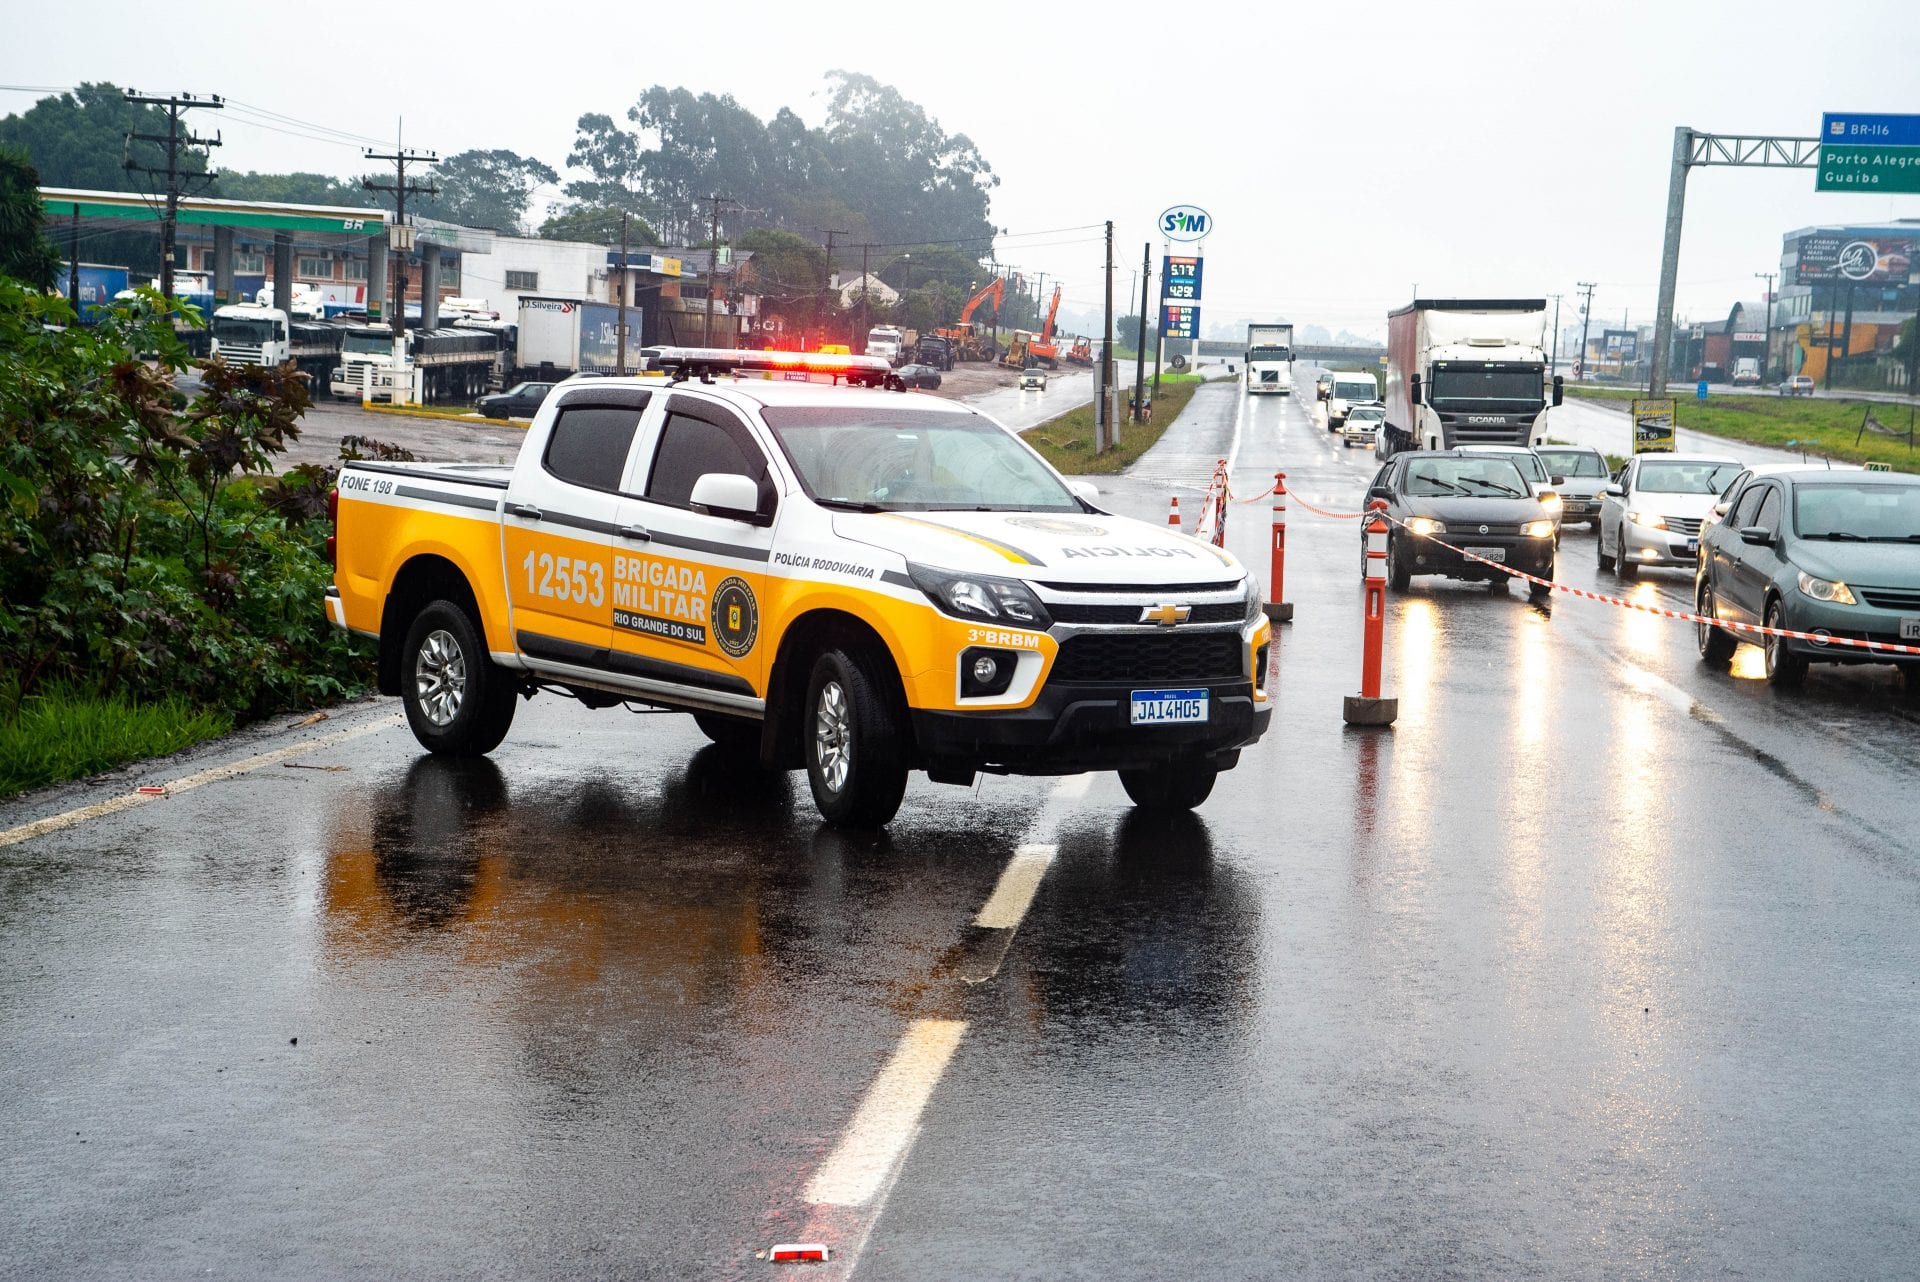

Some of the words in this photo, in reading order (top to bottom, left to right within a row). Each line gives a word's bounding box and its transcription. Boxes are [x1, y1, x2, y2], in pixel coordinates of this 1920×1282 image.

[1851, 124, 1889, 136] BR-116
[1826, 153, 1868, 165] Porto
[1872, 154, 1920, 168] Alegre
[1825, 170, 1879, 183] Guaíba
[343, 220, 364, 230] BR
[526, 301, 562, 311] J.Silveira
[1468, 416, 1506, 424] SCANIA
[1868, 463, 1888, 472] TAXI
[341, 475, 371, 491] FONE
[373, 479, 393, 495] 198
[774, 552, 810, 569] POLÍCIA
[812, 558, 875, 579] RODOVIÁRIA
[523, 550, 605, 608] 12553
[613, 555, 707, 595] BRIGADA
[613, 581, 706, 622] MILITAR
[614, 612, 629, 626] RIO
[631, 616, 668, 634] GRANDE
[671, 626, 684, 639] DO
[686, 631, 705, 642] SUL
[1138, 700, 1201, 719] JAI4H05
